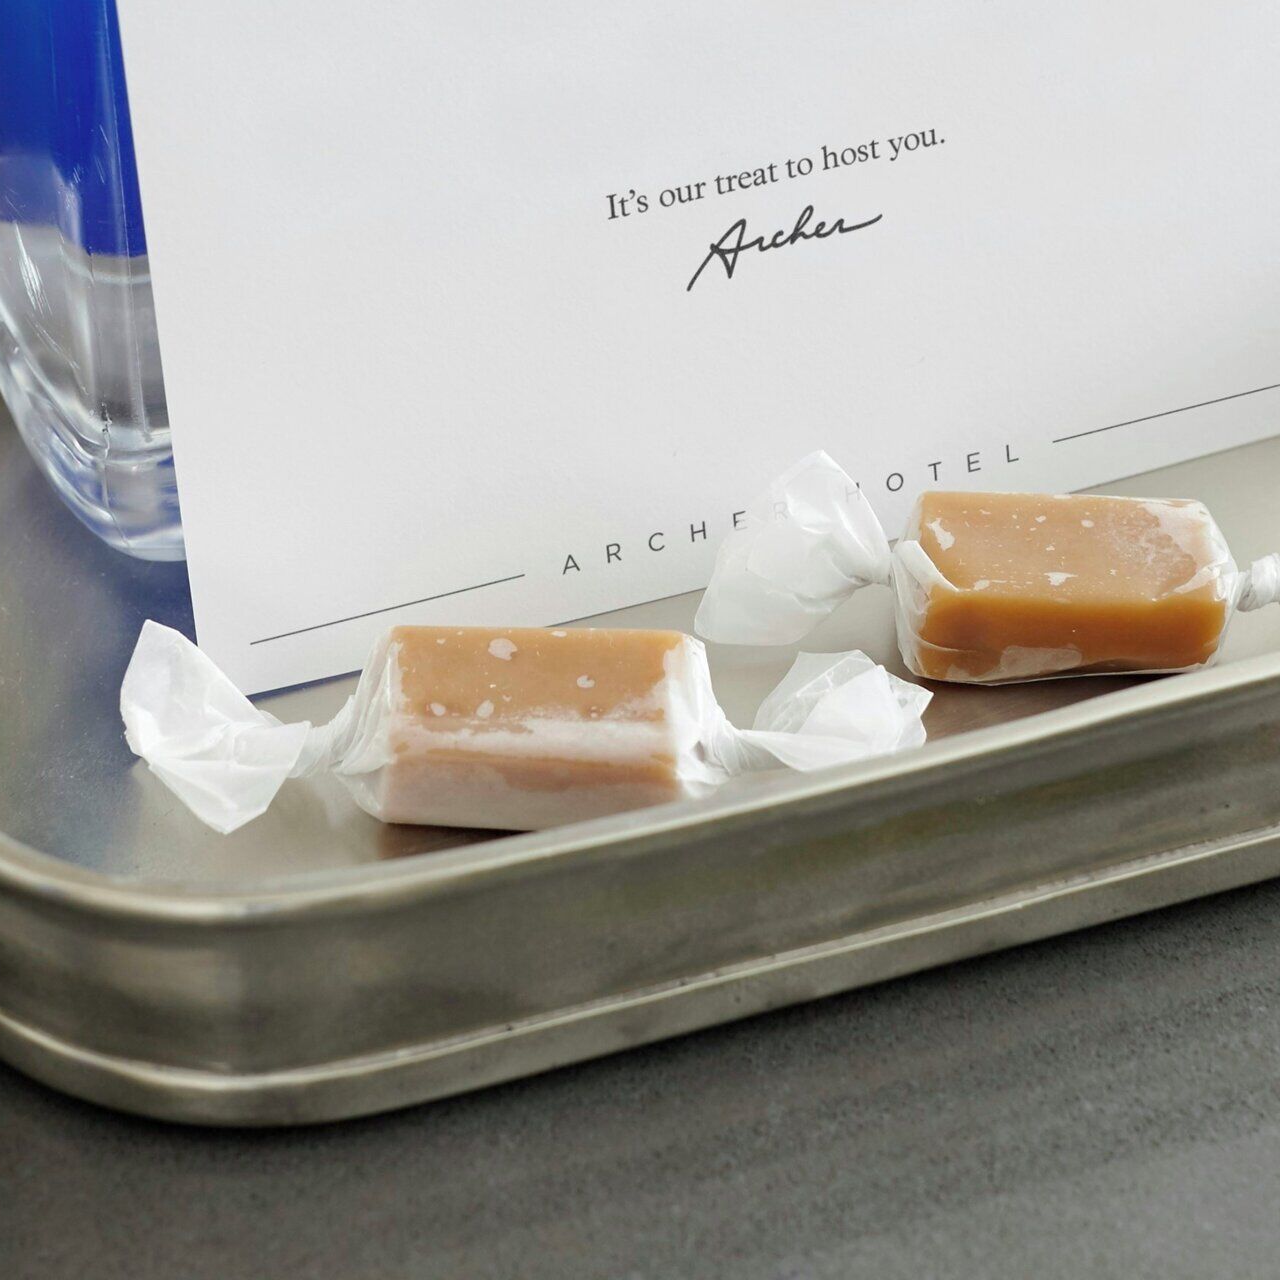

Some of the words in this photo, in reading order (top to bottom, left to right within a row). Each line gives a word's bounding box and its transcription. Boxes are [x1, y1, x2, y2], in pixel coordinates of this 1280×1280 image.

[606, 189, 649, 220] It’s
[659, 181, 707, 208] our
[714, 161, 780, 195] treat
[785, 157, 813, 179] to
[821, 139, 881, 171] host
[887, 128, 946, 162] you.
[686, 204, 883, 292] Archer
